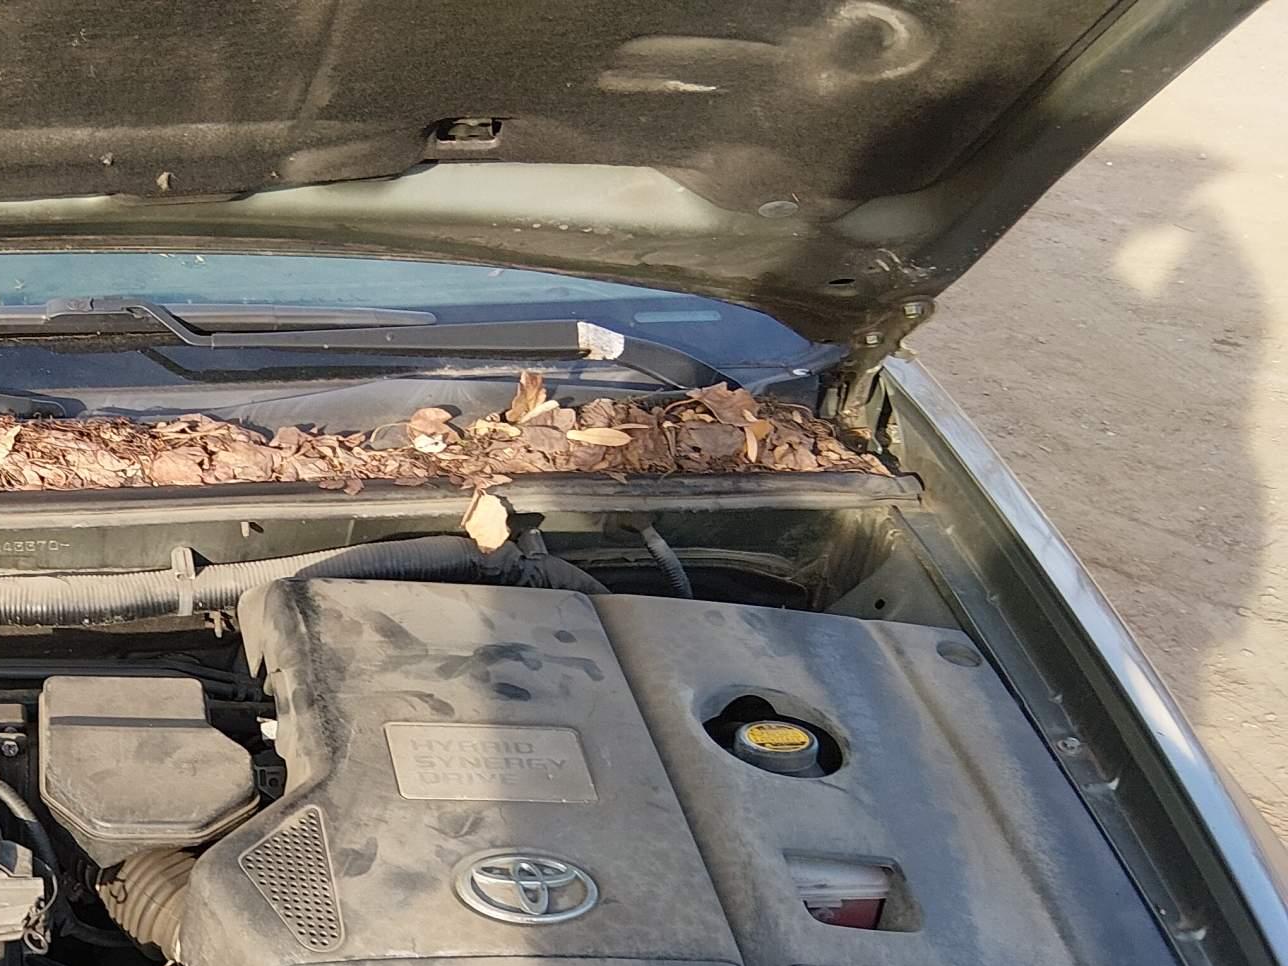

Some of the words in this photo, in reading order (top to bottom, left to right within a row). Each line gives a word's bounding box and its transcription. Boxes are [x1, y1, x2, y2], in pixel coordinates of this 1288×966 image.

[410, 739, 535, 754] HYBRID
[414, 755, 568, 770] SYNERGY
[418, 771, 521, 785] DRIVE
